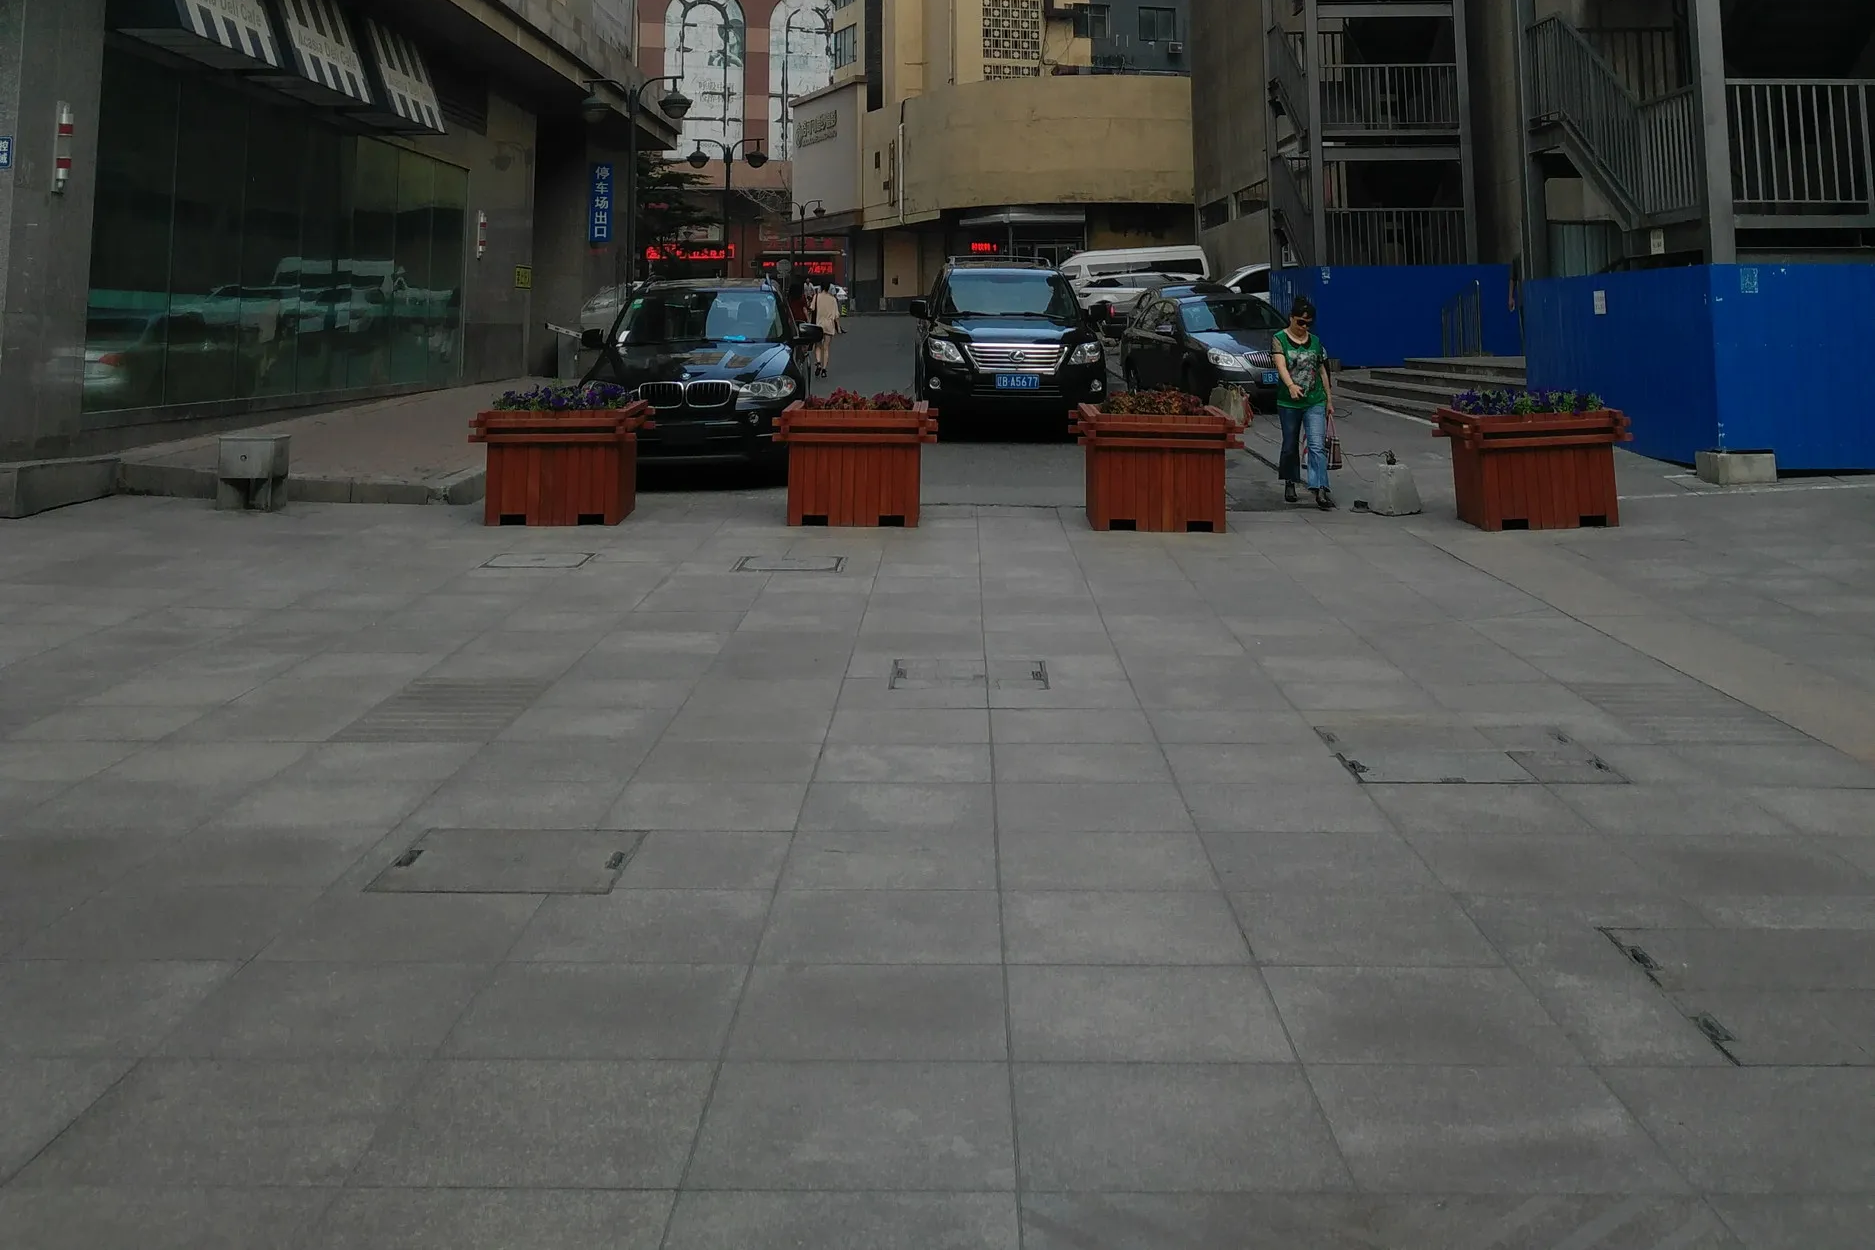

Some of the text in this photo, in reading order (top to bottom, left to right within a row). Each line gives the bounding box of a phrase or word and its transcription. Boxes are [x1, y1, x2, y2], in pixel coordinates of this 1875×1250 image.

[594, 166, 610, 238] 停车场出口
